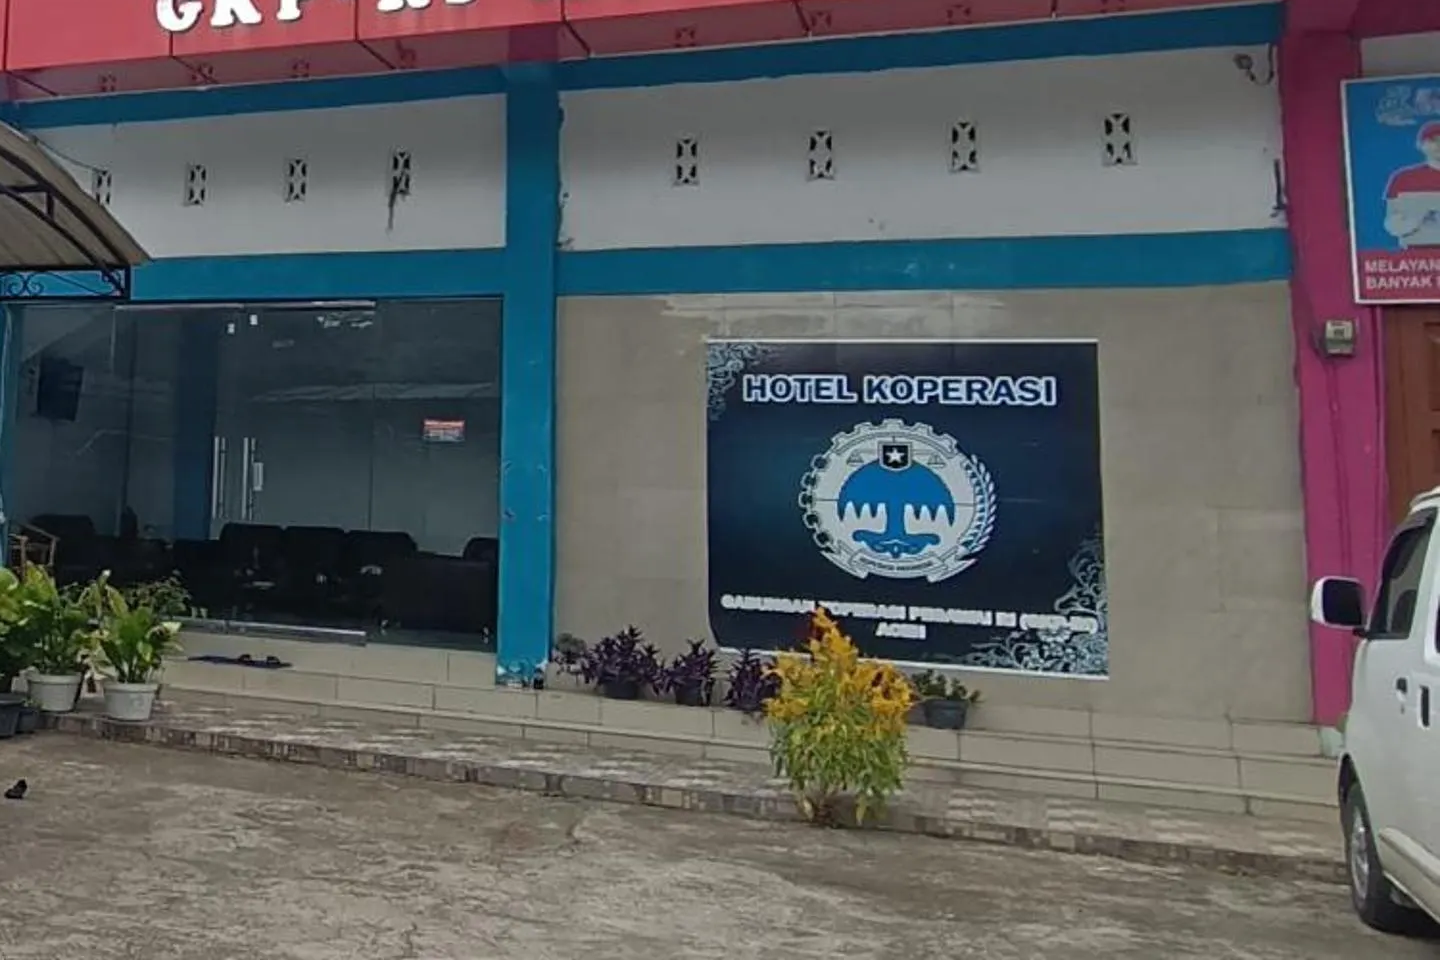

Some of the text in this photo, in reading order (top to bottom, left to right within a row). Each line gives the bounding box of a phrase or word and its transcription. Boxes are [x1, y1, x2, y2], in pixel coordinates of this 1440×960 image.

[1366, 275, 1433, 290] BANYAK
[743, 373, 1057, 406] HOTEL KOPERASI
